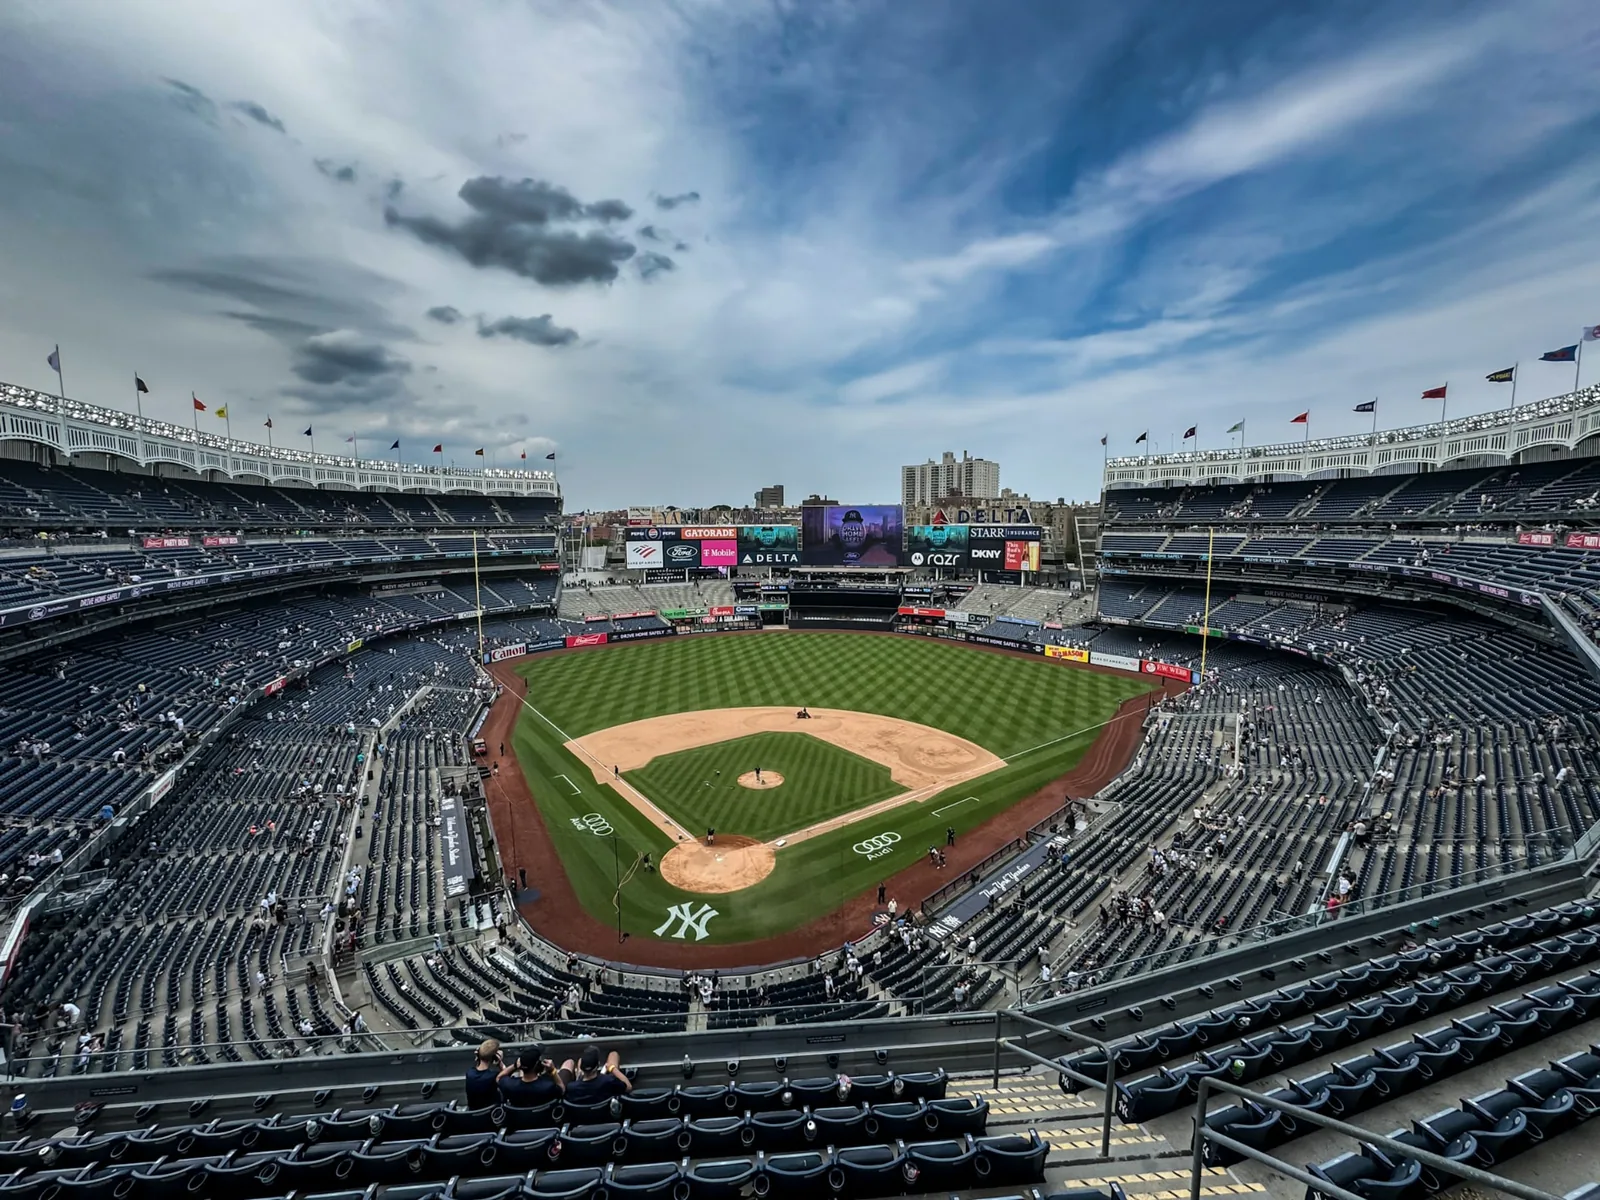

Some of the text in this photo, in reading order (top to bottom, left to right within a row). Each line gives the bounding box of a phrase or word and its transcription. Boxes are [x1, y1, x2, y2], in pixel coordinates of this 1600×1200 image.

[661, 511, 718, 524] YANKEE
[958, 508, 1032, 524] DELTA
[970, 528, 1004, 538] STARR
[1530, 534, 1541, 544] PARTY
[1584, 536, 1598, 546] PARTY
[671, 547, 692, 556] Ford
[972, 550, 1001, 558] DKNY
[756, 554, 798, 562] DELTA
[928, 554, 960, 565] razr
[80, 592, 121, 607] DRIVE HOME SAFELY
[1305, 593, 1328, 601] SAFELY
[492, 646, 525, 661] Canon
[1170, 666, 1187, 676] WEBB
[867, 847, 894, 860] Audi
[979, 864, 1030, 898] New York Yankees
[653, 901, 720, 941] NY
[1061, 1074, 1070, 1089] NY
[1118, 1100, 1129, 1118] NY
